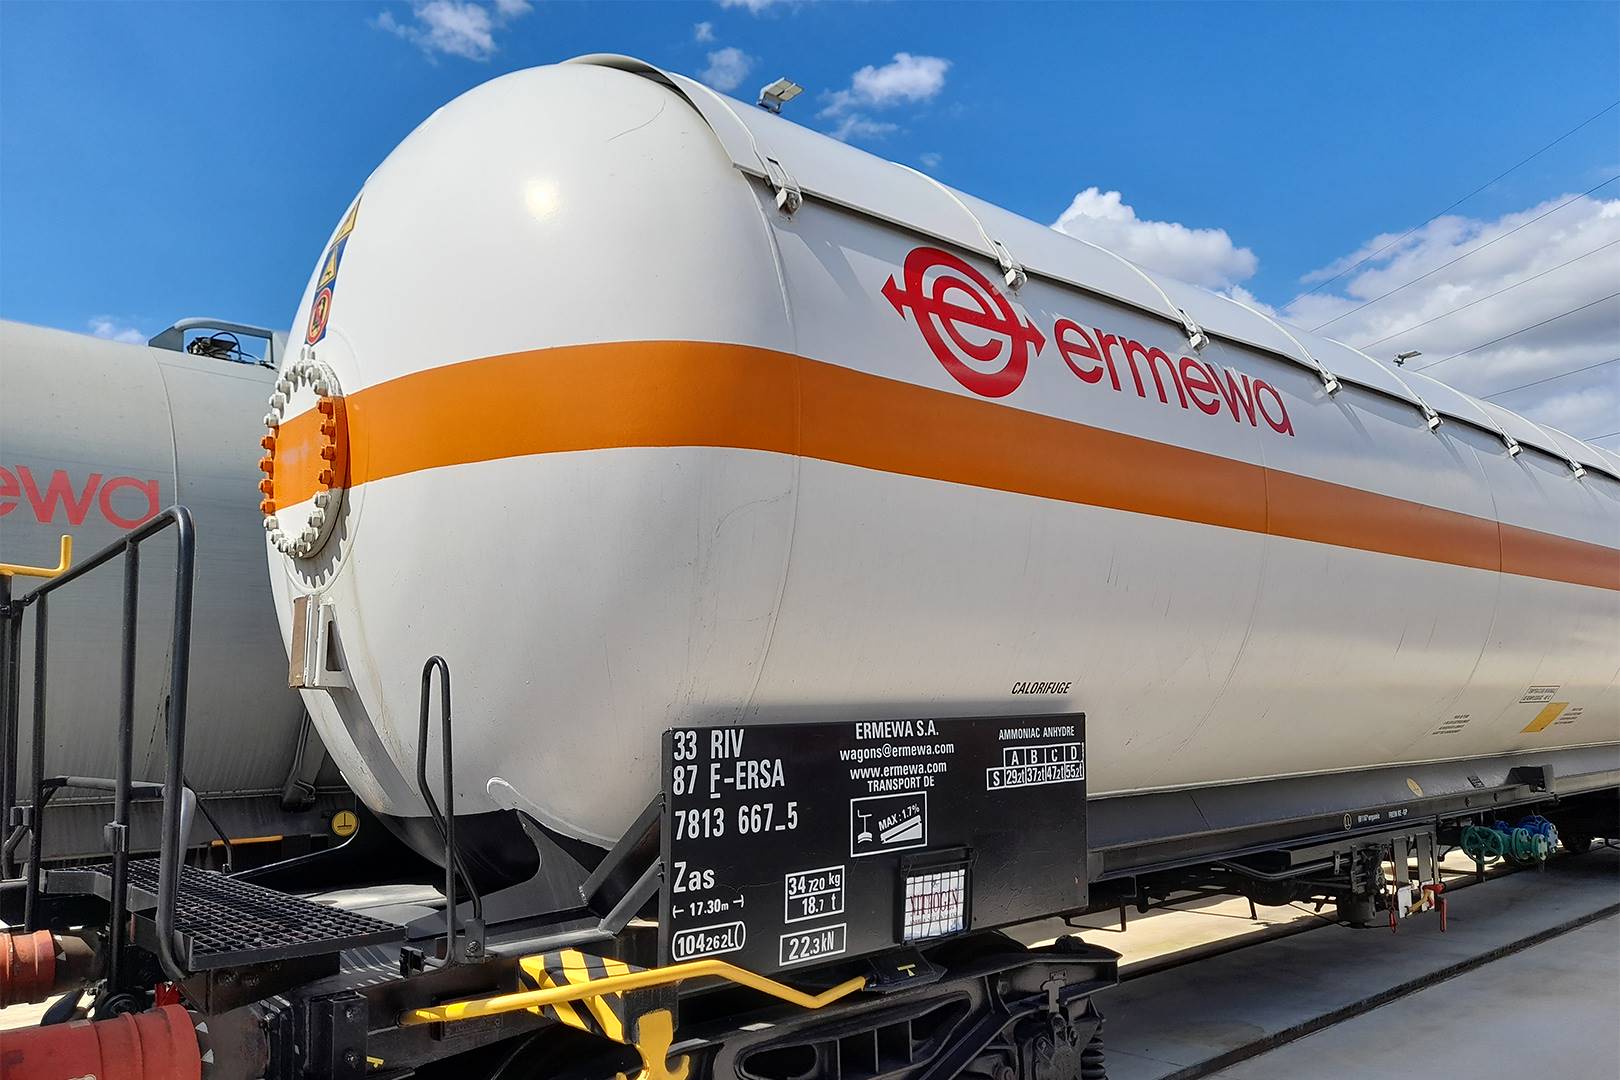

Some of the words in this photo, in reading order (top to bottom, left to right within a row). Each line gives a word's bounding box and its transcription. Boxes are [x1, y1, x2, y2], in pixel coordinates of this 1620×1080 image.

[1054, 318, 1294, 437] ermewa
[1011, 681, 1072, 695] CALORIFUGE
[855, 721, 914, 740] ERMEWA
[916, 720, 939, 737] S.A.
[999, 728, 1040, 740] AMMONIAC
[1043, 726, 1075, 738] ANHYDRE
[673, 730, 697, 761] 33
[710, 728, 745, 759] RIV
[839, 743, 955, 763] wagons@ermewa.com
[1011, 750, 1019, 766] A
[1031, 749, 1038, 764] B
[1051, 748, 1058, 762] C
[1070, 745, 1077, 760] D
[672, 764, 698, 796] 87
[850, 762, 947, 780] www.ermewa.com
[992, 770, 1000, 787] S
[867, 777, 921, 793] TRANSPORT
[923, 775, 935, 788] DE
[674, 807, 725, 841] 7813
[673, 861, 715, 894] Zas
[829, 872, 840, 887] kg
[831, 893, 836, 910] t
